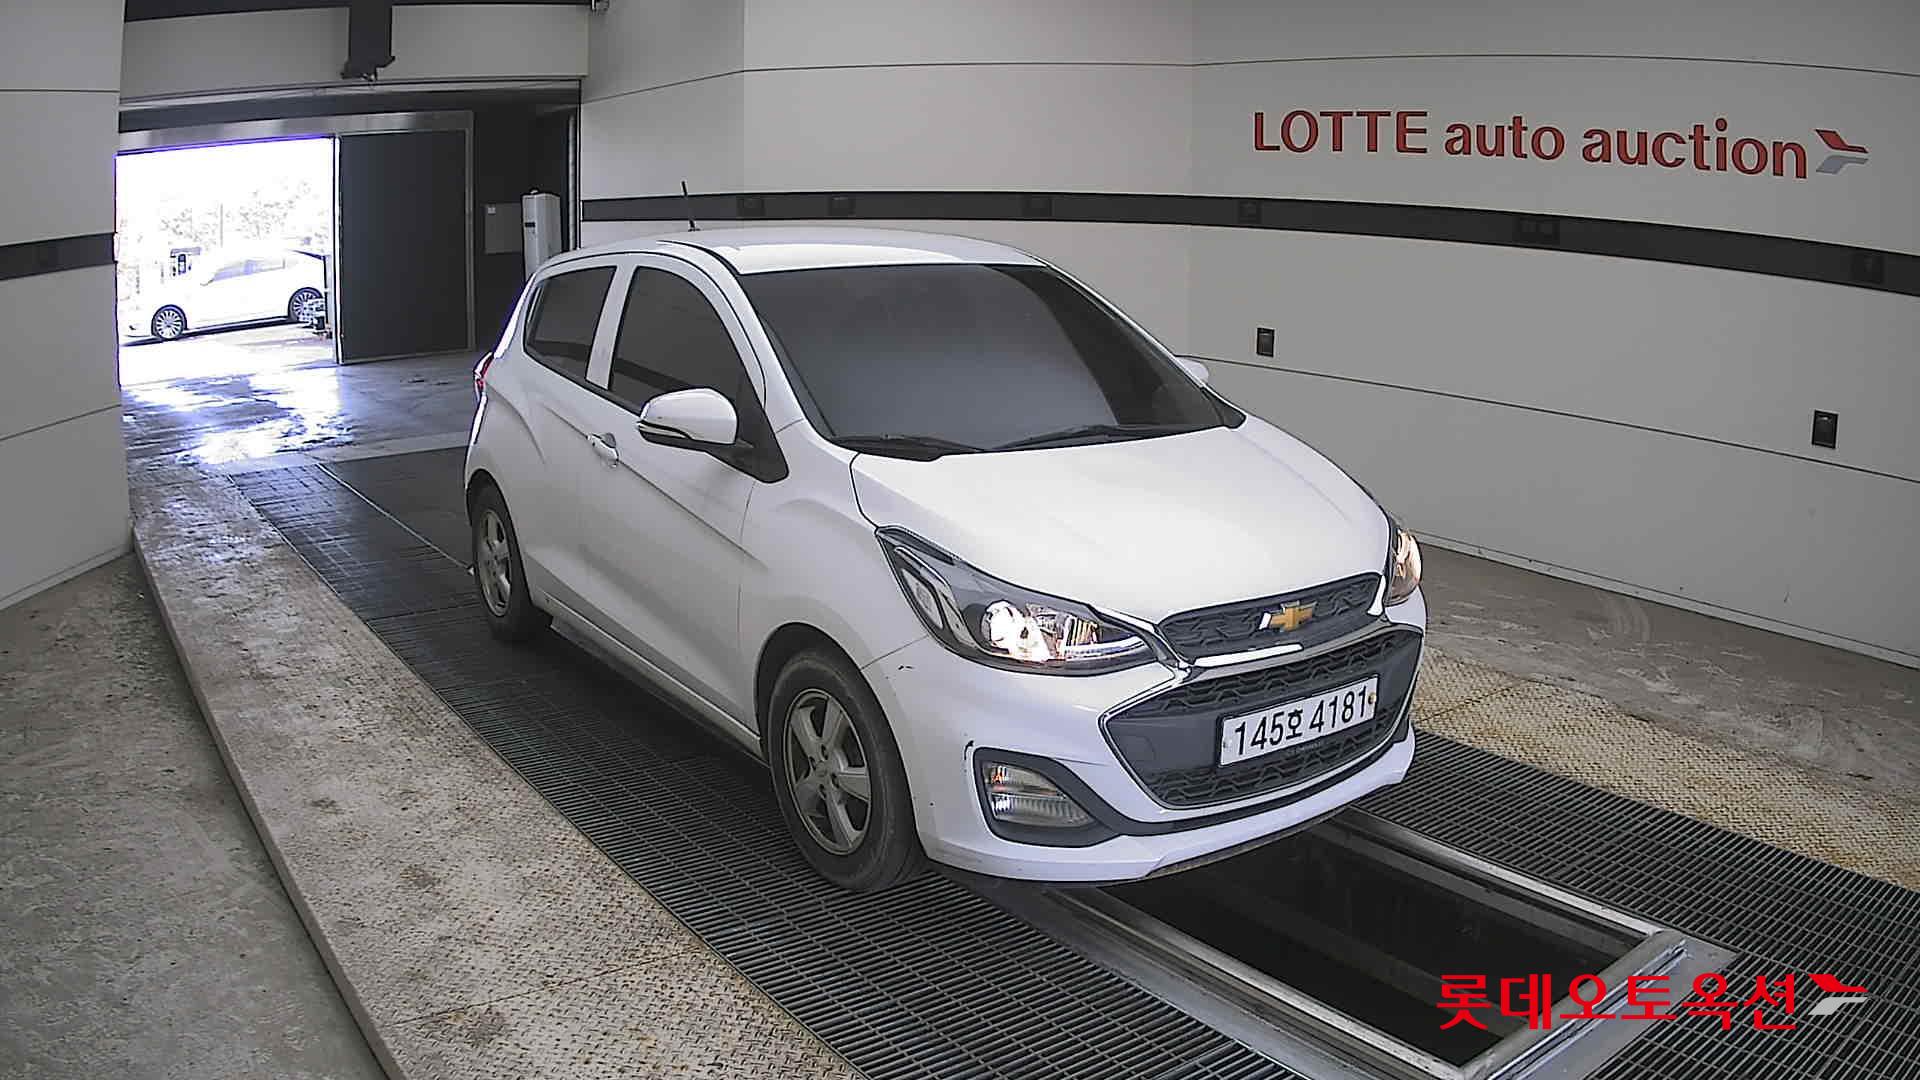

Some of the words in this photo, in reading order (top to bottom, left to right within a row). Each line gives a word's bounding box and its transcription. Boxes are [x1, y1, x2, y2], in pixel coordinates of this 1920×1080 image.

[1253, 110, 1428, 154] LOTTE
[1444, 115, 1566, 160] auto
[1581, 118, 1808, 179] auction
[1235, 709, 1304, 755] 145호
[1309, 685, 1367, 733] 4181
